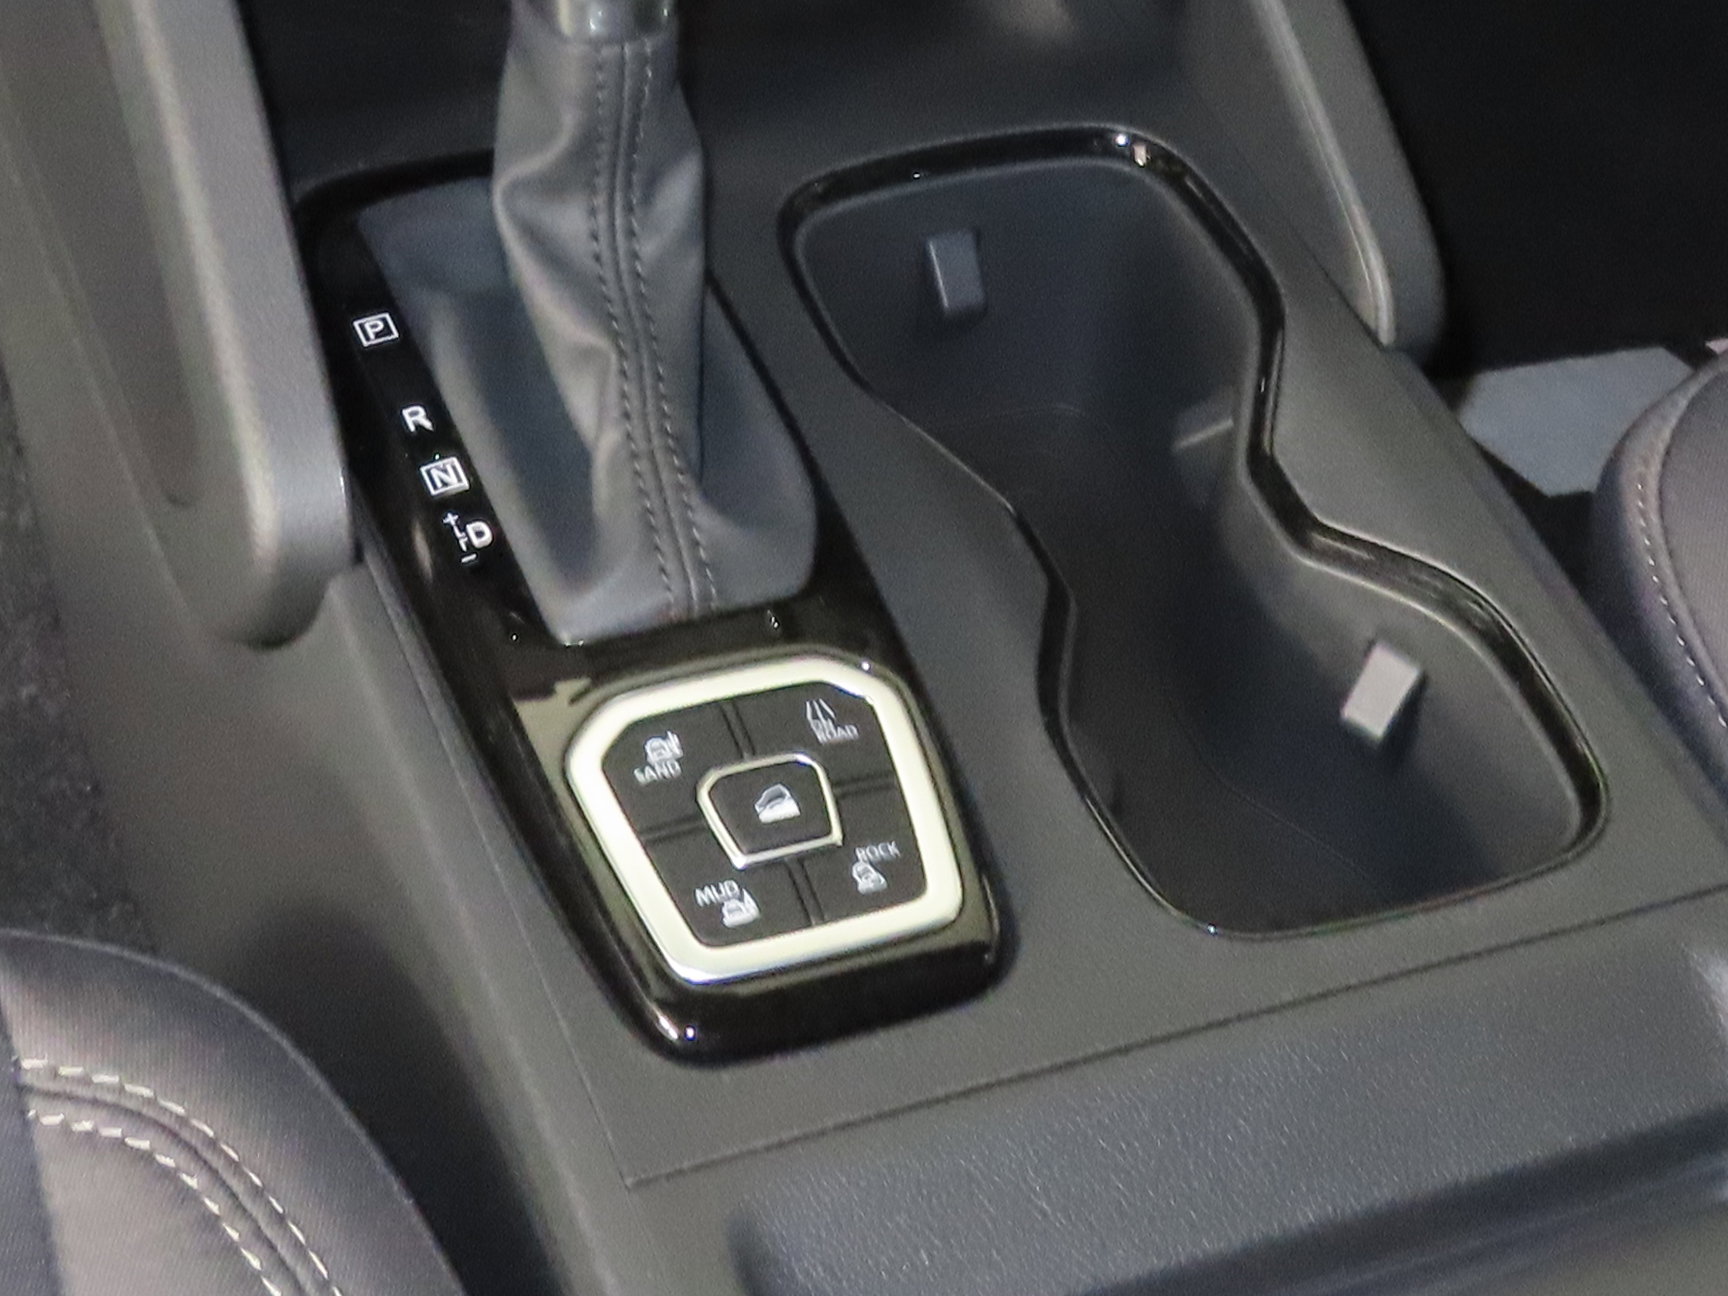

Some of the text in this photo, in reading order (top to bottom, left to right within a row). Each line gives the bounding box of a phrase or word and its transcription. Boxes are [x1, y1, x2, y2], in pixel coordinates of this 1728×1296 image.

[402, 405, 434, 433] R
[466, 520, 493, 549] D
[816, 724, 860, 744] ROAD
[633, 761, 682, 785] SAND
[855, 841, 901, 862] ROCK
[694, 879, 741, 907] MUD
